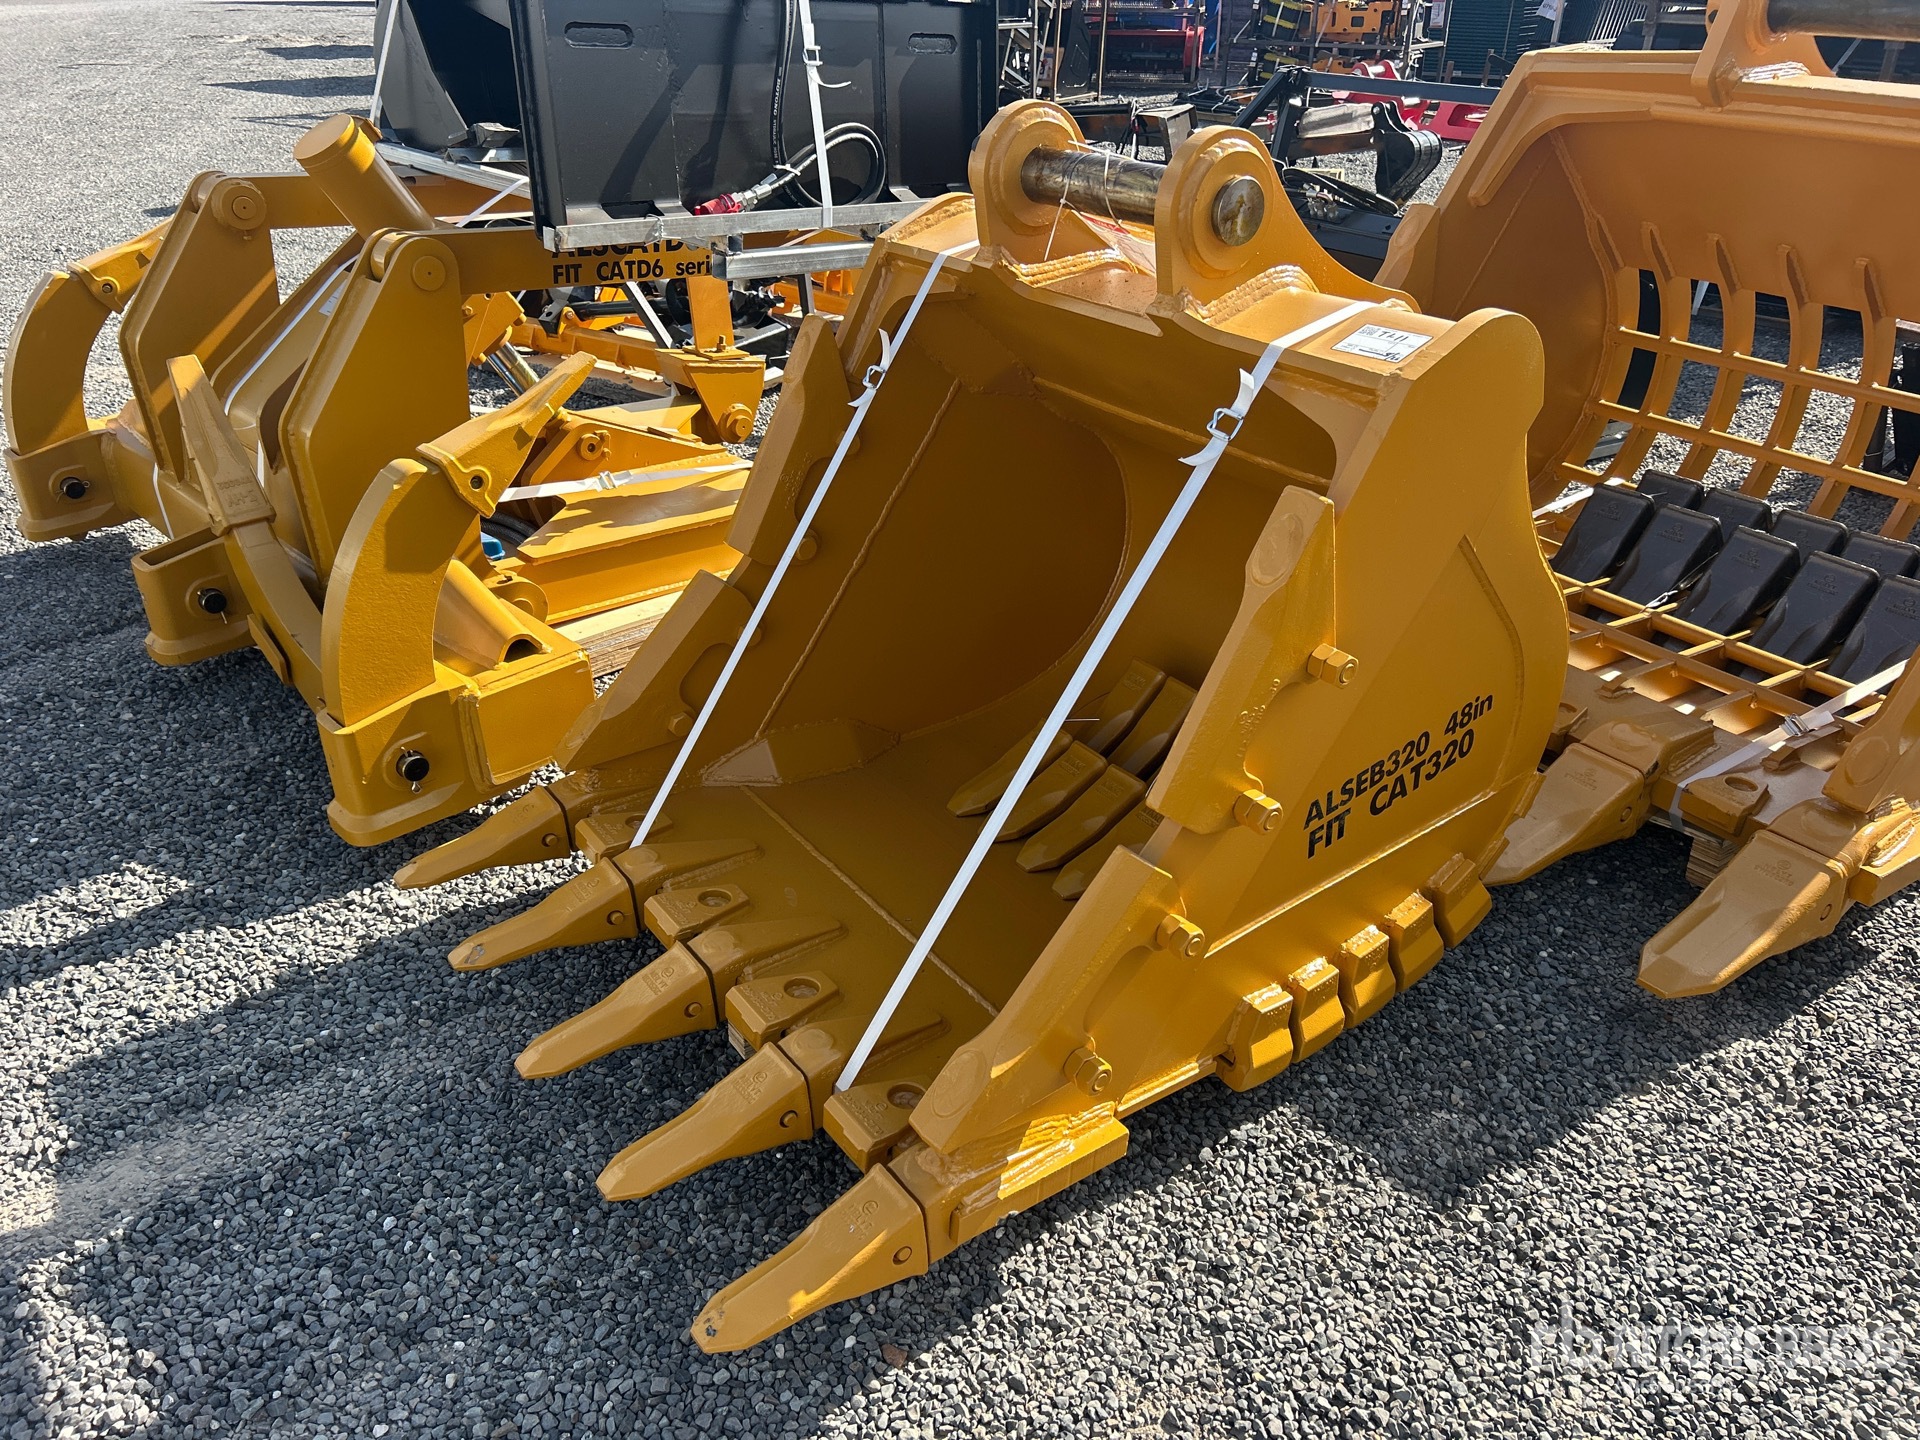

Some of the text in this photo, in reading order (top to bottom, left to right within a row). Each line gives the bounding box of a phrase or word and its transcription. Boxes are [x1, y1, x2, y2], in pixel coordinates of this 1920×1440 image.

[553, 255, 712, 284] FIT CATD6 seri
[1303, 731, 1430, 830] ALSEB320
[1444, 694, 1493, 736] 48in
[1308, 729, 1475, 859] FIT CAT320
